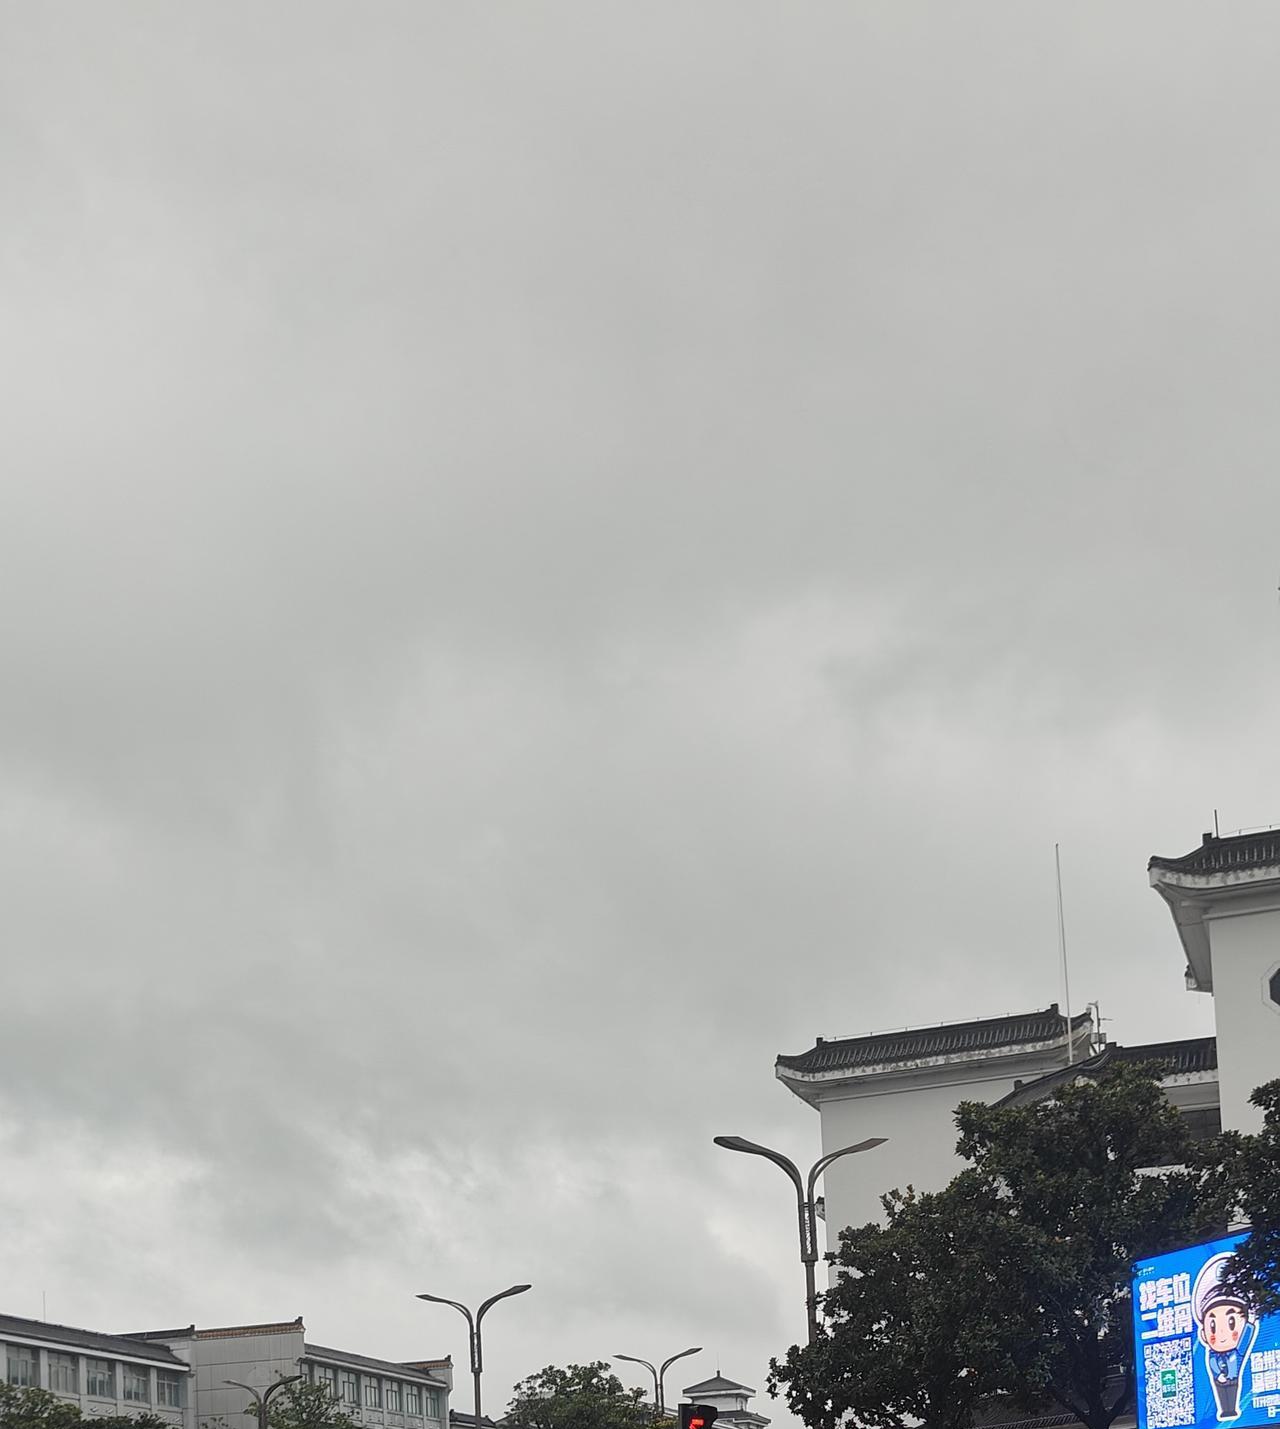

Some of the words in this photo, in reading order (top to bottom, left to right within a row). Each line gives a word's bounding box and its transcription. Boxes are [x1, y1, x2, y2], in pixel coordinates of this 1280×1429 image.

[1139, 1273, 1191, 1311] 找车位
[1141, 1303, 1193, 1340] 二维码
